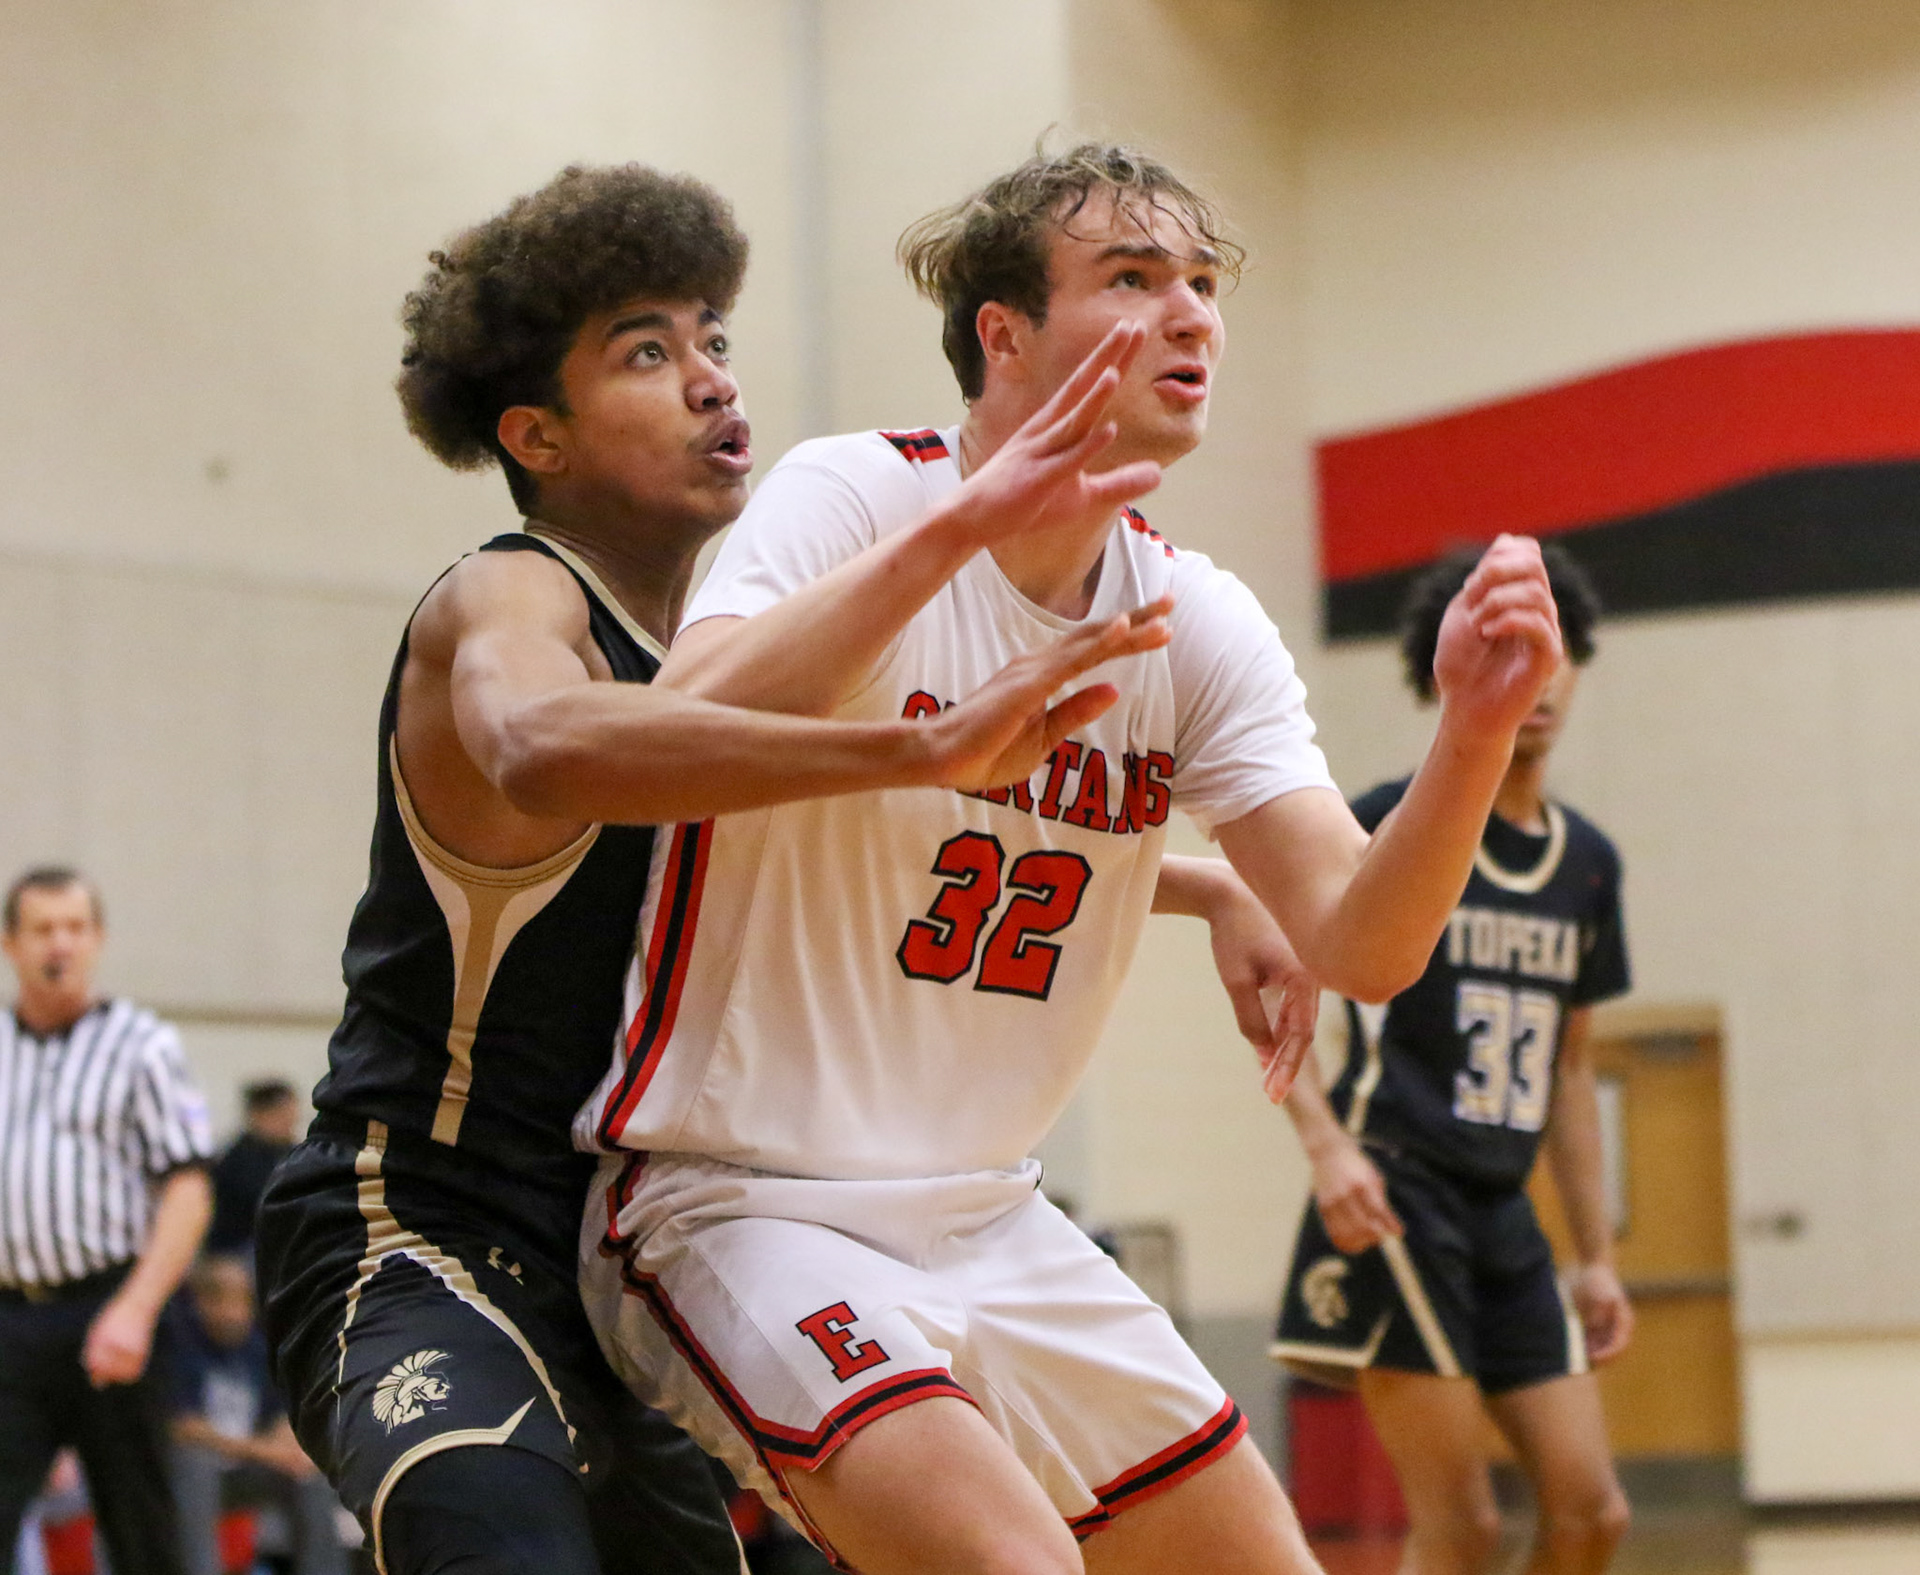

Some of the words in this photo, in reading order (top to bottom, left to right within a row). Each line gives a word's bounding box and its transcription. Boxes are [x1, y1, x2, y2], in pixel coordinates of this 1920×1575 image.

[896, 829, 1093, 1002] 32
[1453, 978, 1558, 1133] 33
[795, 1300, 891, 1384] E
